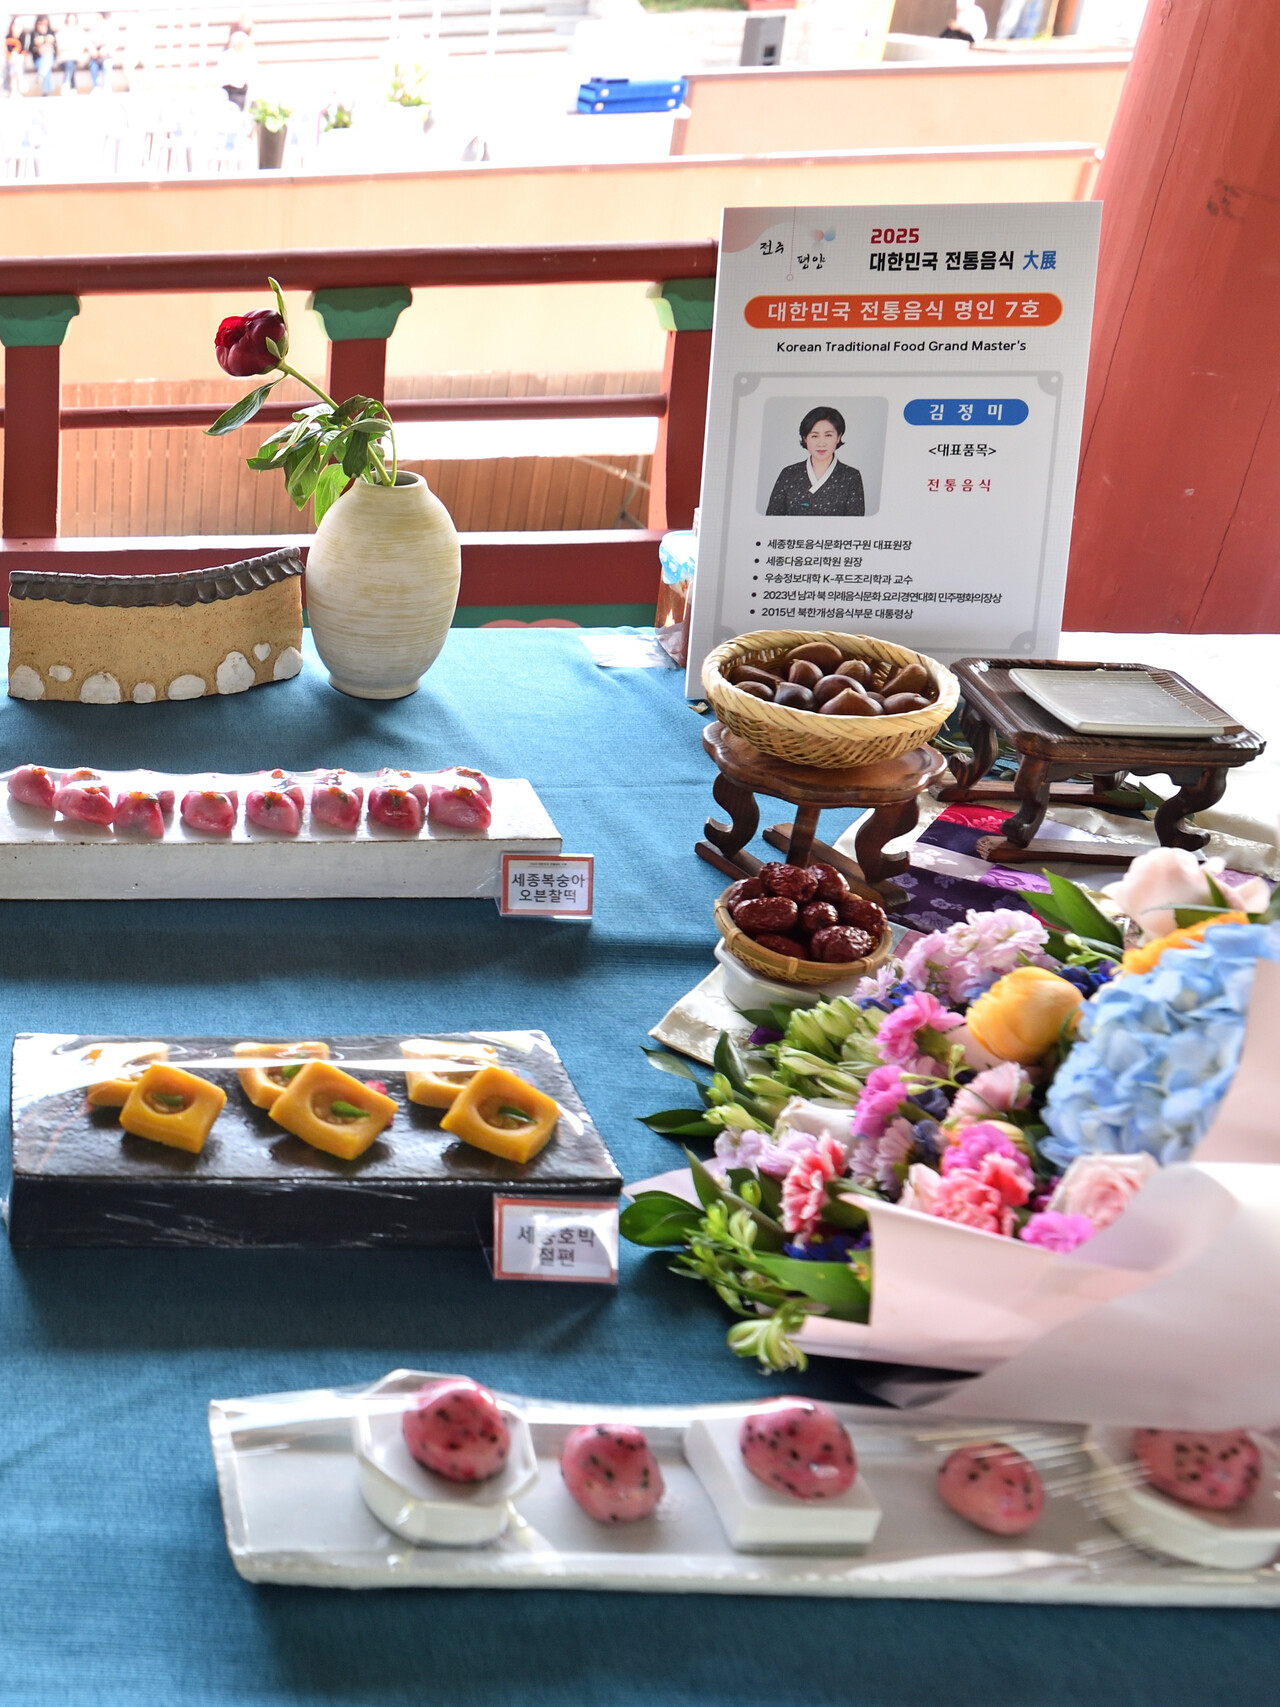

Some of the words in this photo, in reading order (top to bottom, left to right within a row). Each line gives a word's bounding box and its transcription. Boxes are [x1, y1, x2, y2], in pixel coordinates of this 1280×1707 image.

[870, 228, 920, 244] 2025
[760, 240, 785, 256] 전주
[796, 253, 826, 271] 평양
[869, 252, 938, 272] 대한민국
[945, 250, 1014, 271] 전통음식
[1022, 250, 1057, 270] 大展
[767, 301, 851, 322] 대한민국
[860, 300, 943, 321] 전통음식
[954, 300, 995, 320] 명인
[1005, 299, 1040, 319] 7호
[777, 341, 822, 352] Korean
[825, 341, 891, 352] Traditional
[893, 340, 925, 352] Food
[928, 340, 968, 352] Grand
[971, 340, 1026, 351] Master's
[928, 443, 997, 457] <대표품목>
[767, 539, 871, 551] 세종향토음식문화연구원
[873, 540, 913, 551] 대표원장
[843, 557, 863, 568] 원장
[764, 573, 821, 584] 우송정보대학
[823, 574, 892, 585] K-푸드조리학과
[893, 574, 913, 585] 교수
[763, 590, 797, 601] 2023년
[798, 590, 816, 601] 남과
[817, 591, 827, 601] 북
[882, 591, 937, 602] 요리경연대회
[761, 607, 796, 618] 2015년
[797, 608, 873, 619] 북한개성음식부문
[875, 609, 914, 620] 대통령상
[512, 873, 585, 888] 세종복숭아
[519, 889, 577, 904] 오븐찰떡
